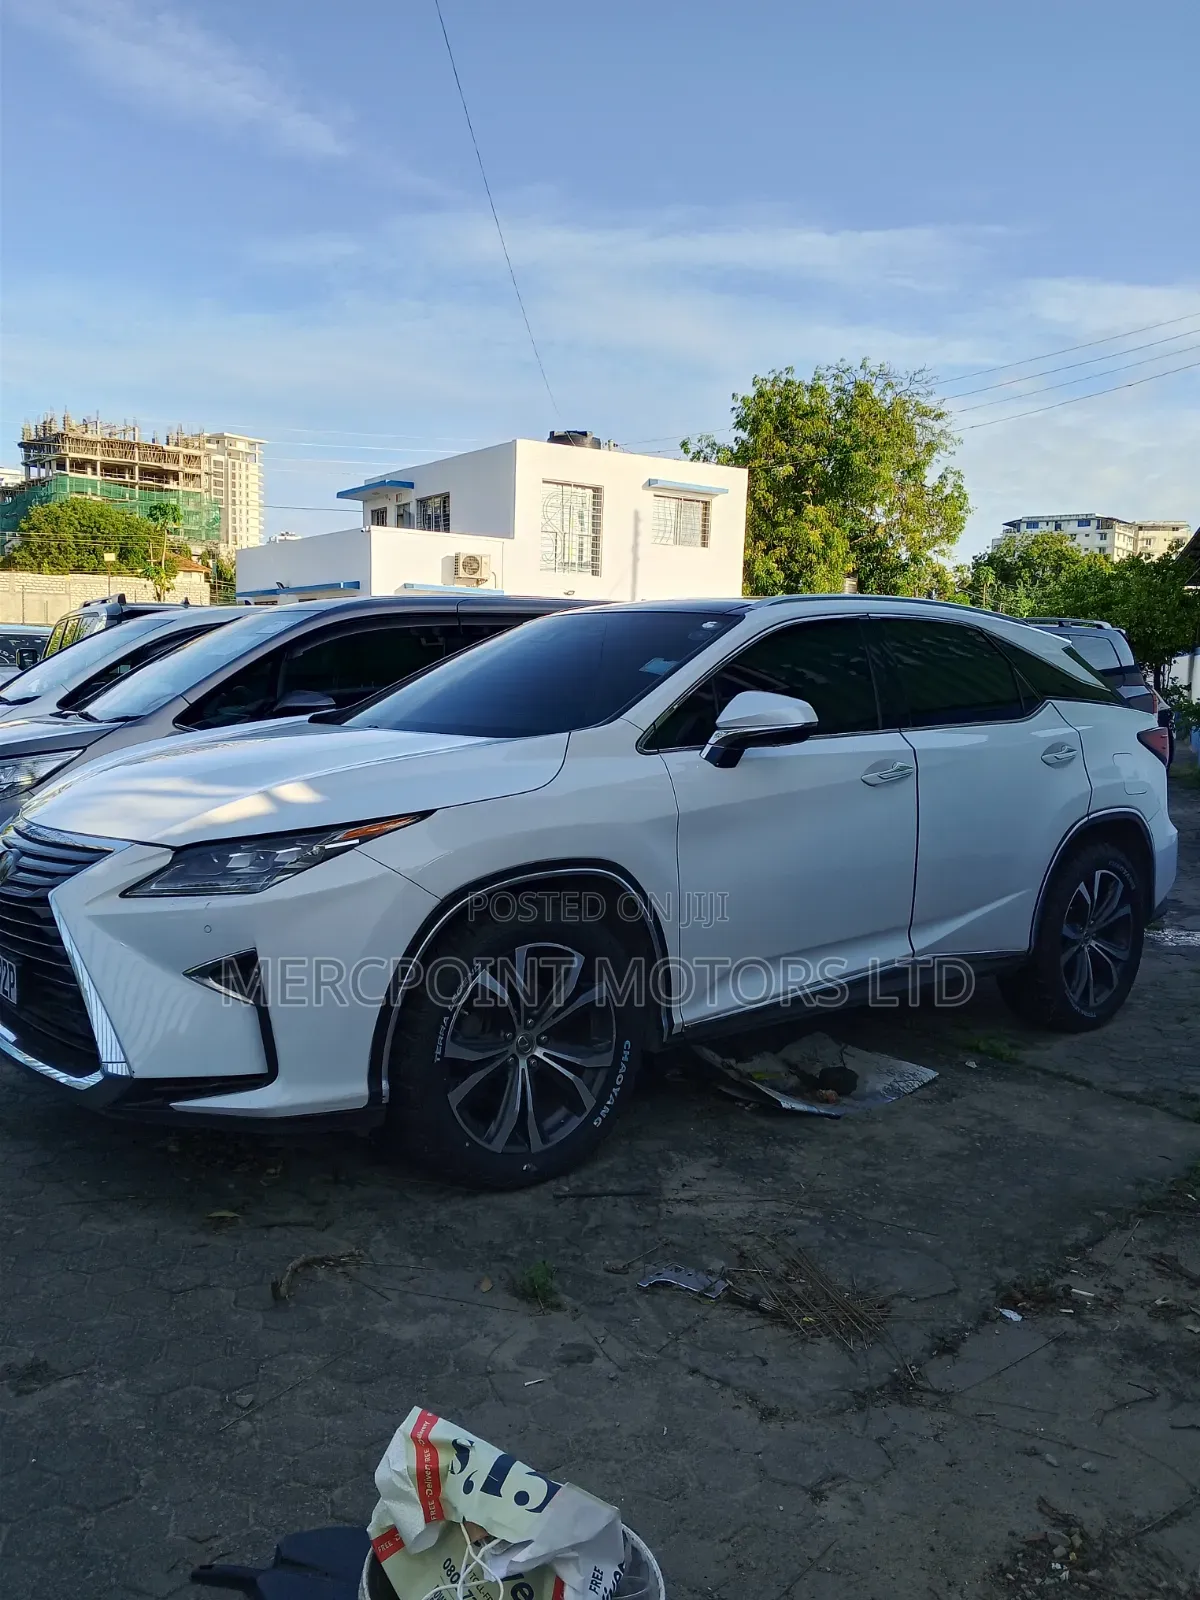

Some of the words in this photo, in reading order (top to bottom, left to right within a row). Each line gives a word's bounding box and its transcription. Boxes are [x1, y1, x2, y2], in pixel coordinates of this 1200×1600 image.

[593, 1039, 632, 1128] CHAOYANG
[428, 1500, 436, 1521] FREE
[589, 1565, 604, 1595] FREE
